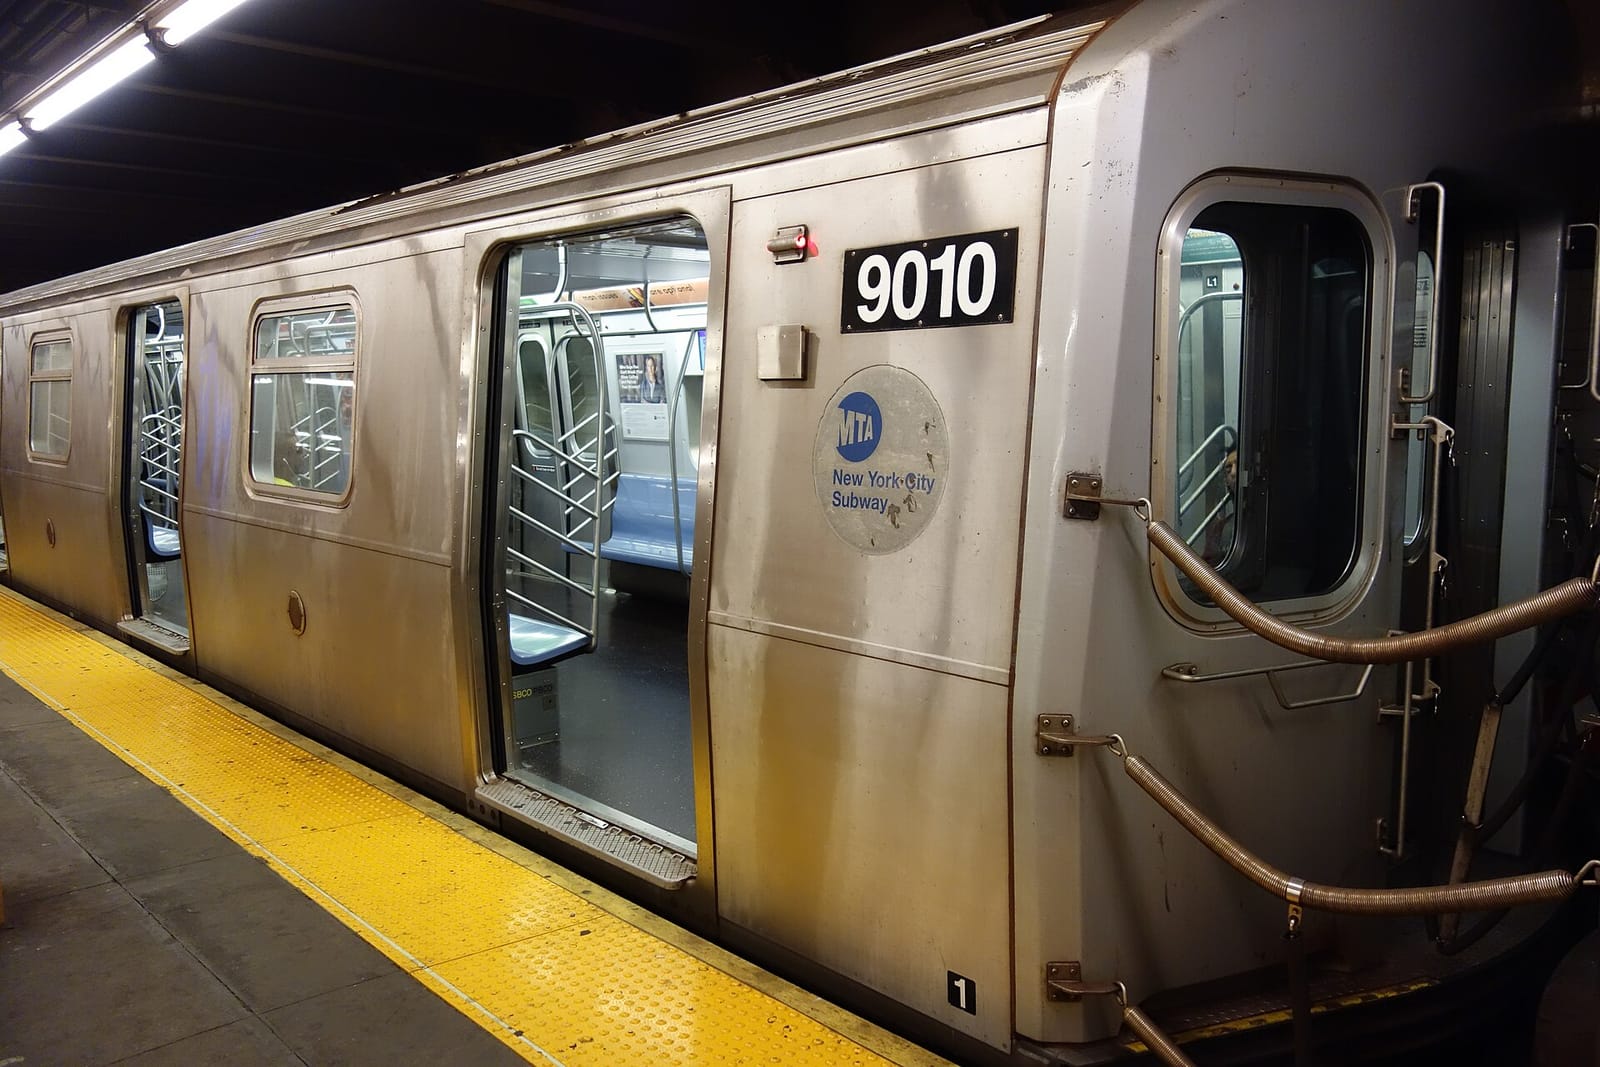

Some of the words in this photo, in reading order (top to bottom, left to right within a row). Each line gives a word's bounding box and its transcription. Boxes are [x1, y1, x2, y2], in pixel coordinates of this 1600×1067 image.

[857, 241, 997, 323] 9010
[1207, 277, 1217, 287] L1
[837, 407, 873, 447] MTA
[833, 469, 863, 486] New
[868, 470, 904, 488] York
[905, 472, 935, 495] City
[832, 491, 888, 514] Subway
[954, 978, 966, 1009] 1
